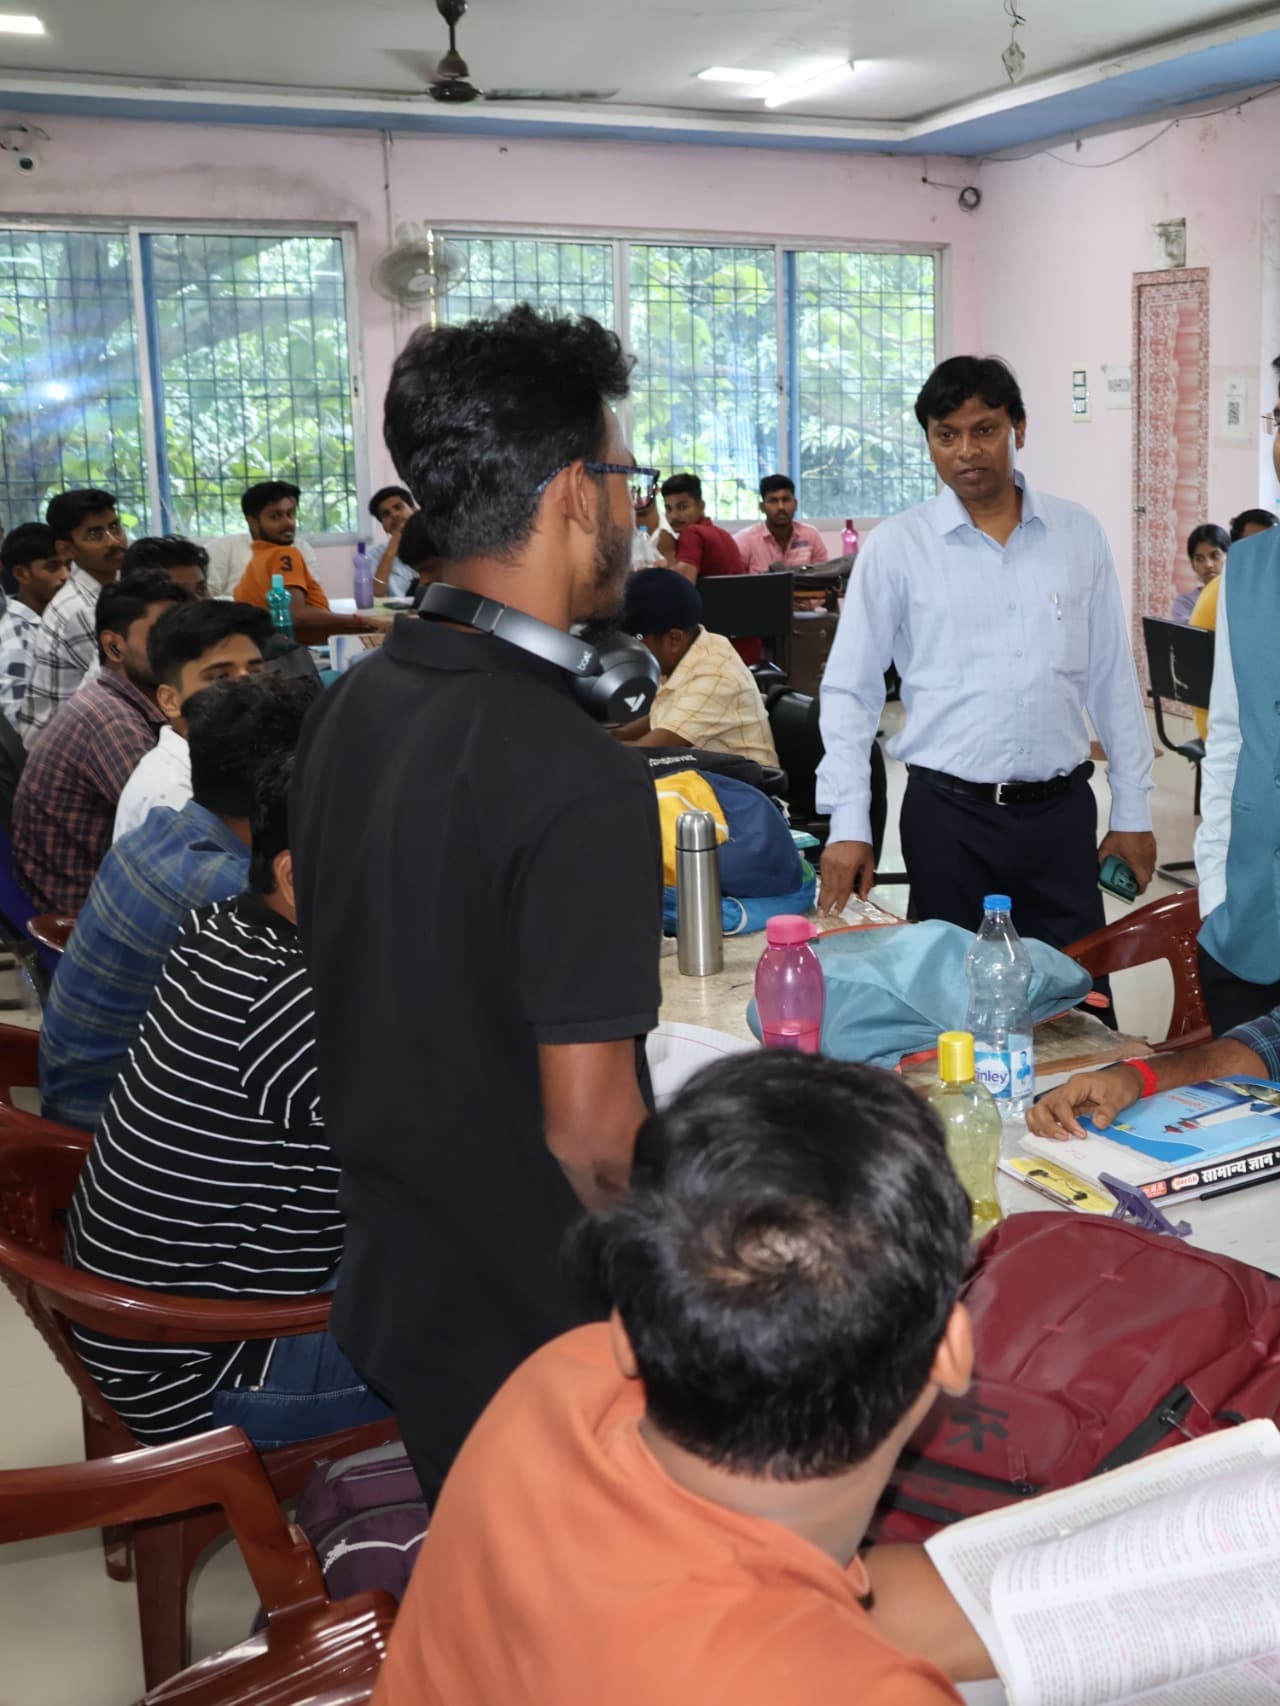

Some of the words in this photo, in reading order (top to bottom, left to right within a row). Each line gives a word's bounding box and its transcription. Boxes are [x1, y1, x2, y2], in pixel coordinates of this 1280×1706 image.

[280, 555, 292, 571] 3
[976, 1070, 1008, 1085] inley
[1201, 1160, 1247, 1183] सामान्य
[1247, 1153, 1273, 1171] ज्ञान
